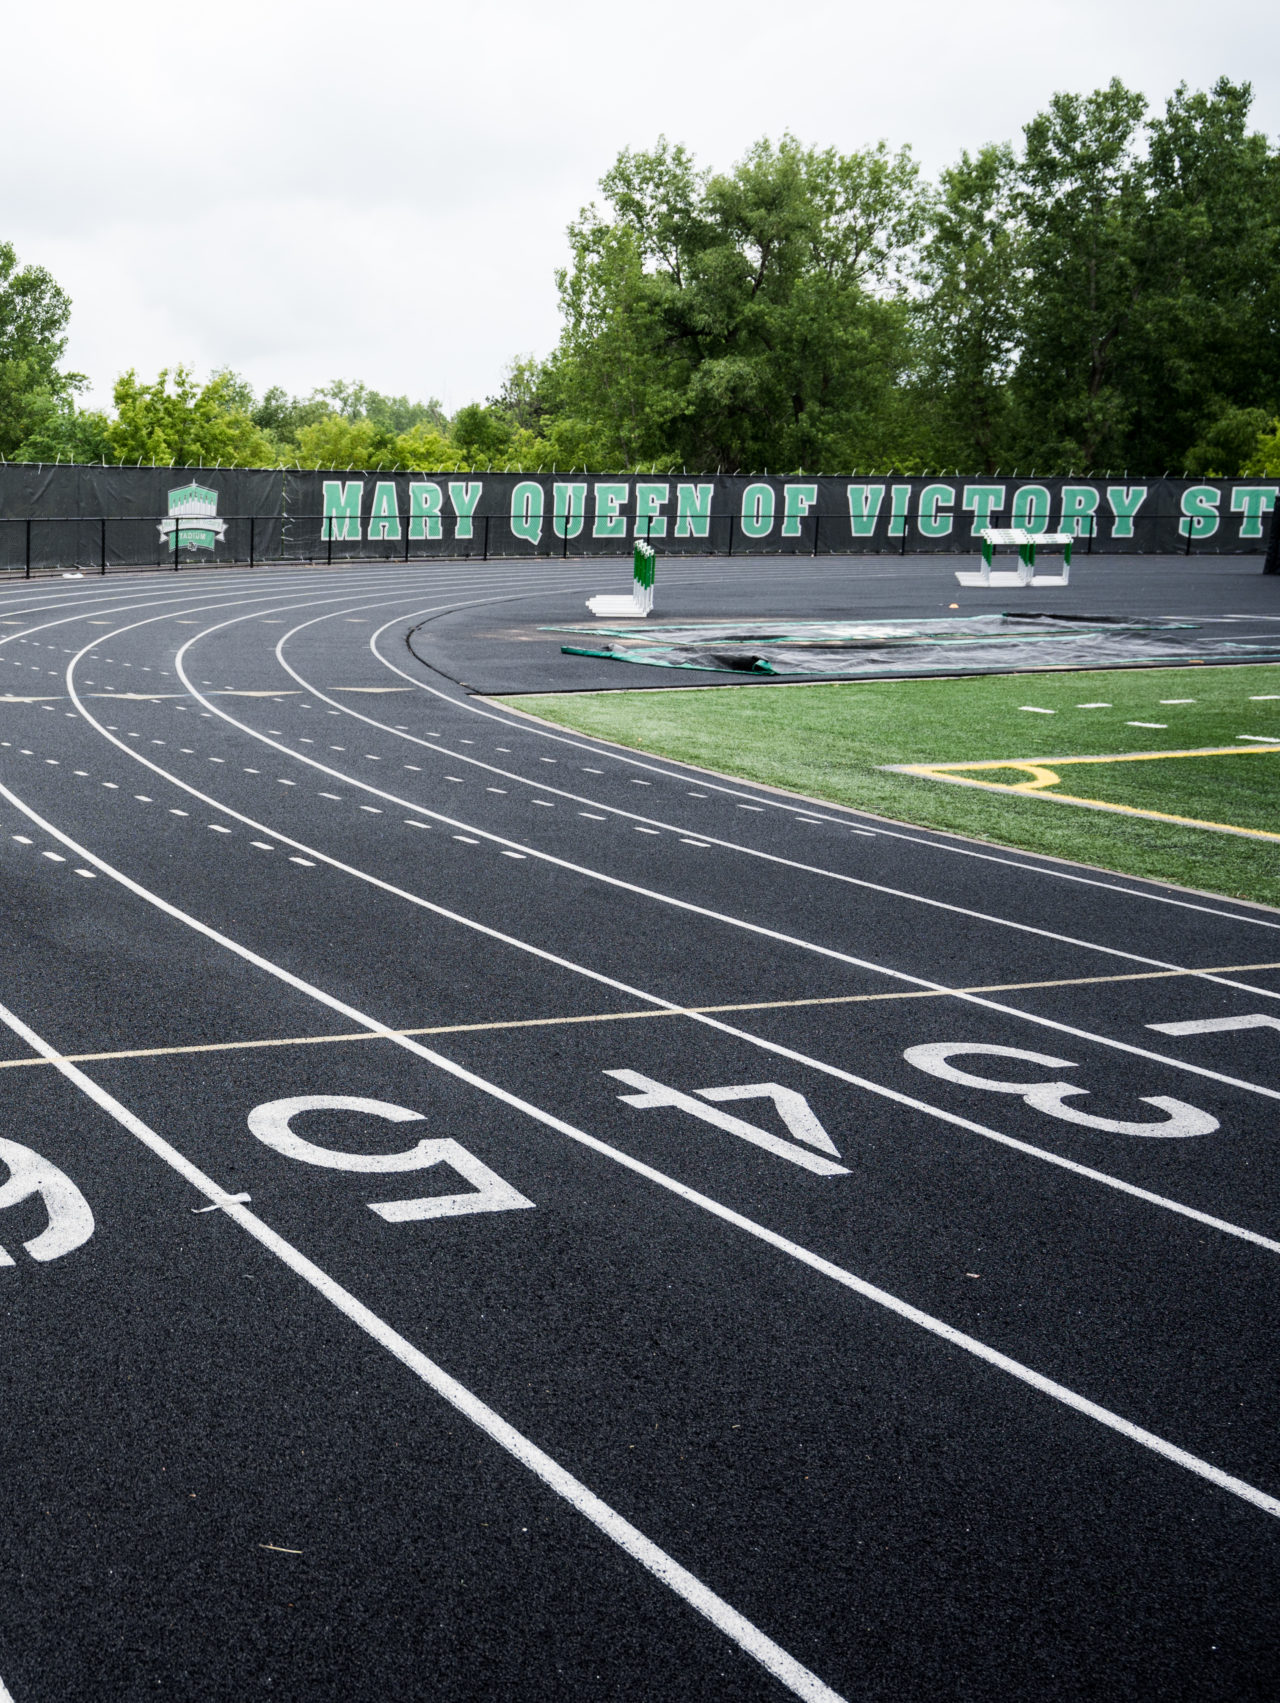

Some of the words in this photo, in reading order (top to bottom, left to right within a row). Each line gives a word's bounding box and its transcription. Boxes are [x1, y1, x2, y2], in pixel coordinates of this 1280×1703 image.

[321, 481, 483, 541] MARY
[510, 481, 714, 545] QUEEN
[741, 483, 818, 538] OF
[847, 484, 1148, 538] VICTORY
[603, 1069, 851, 1176] 4
[903, 1042, 1220, 1137] 3
[247, 1095, 536, 1222] 5
